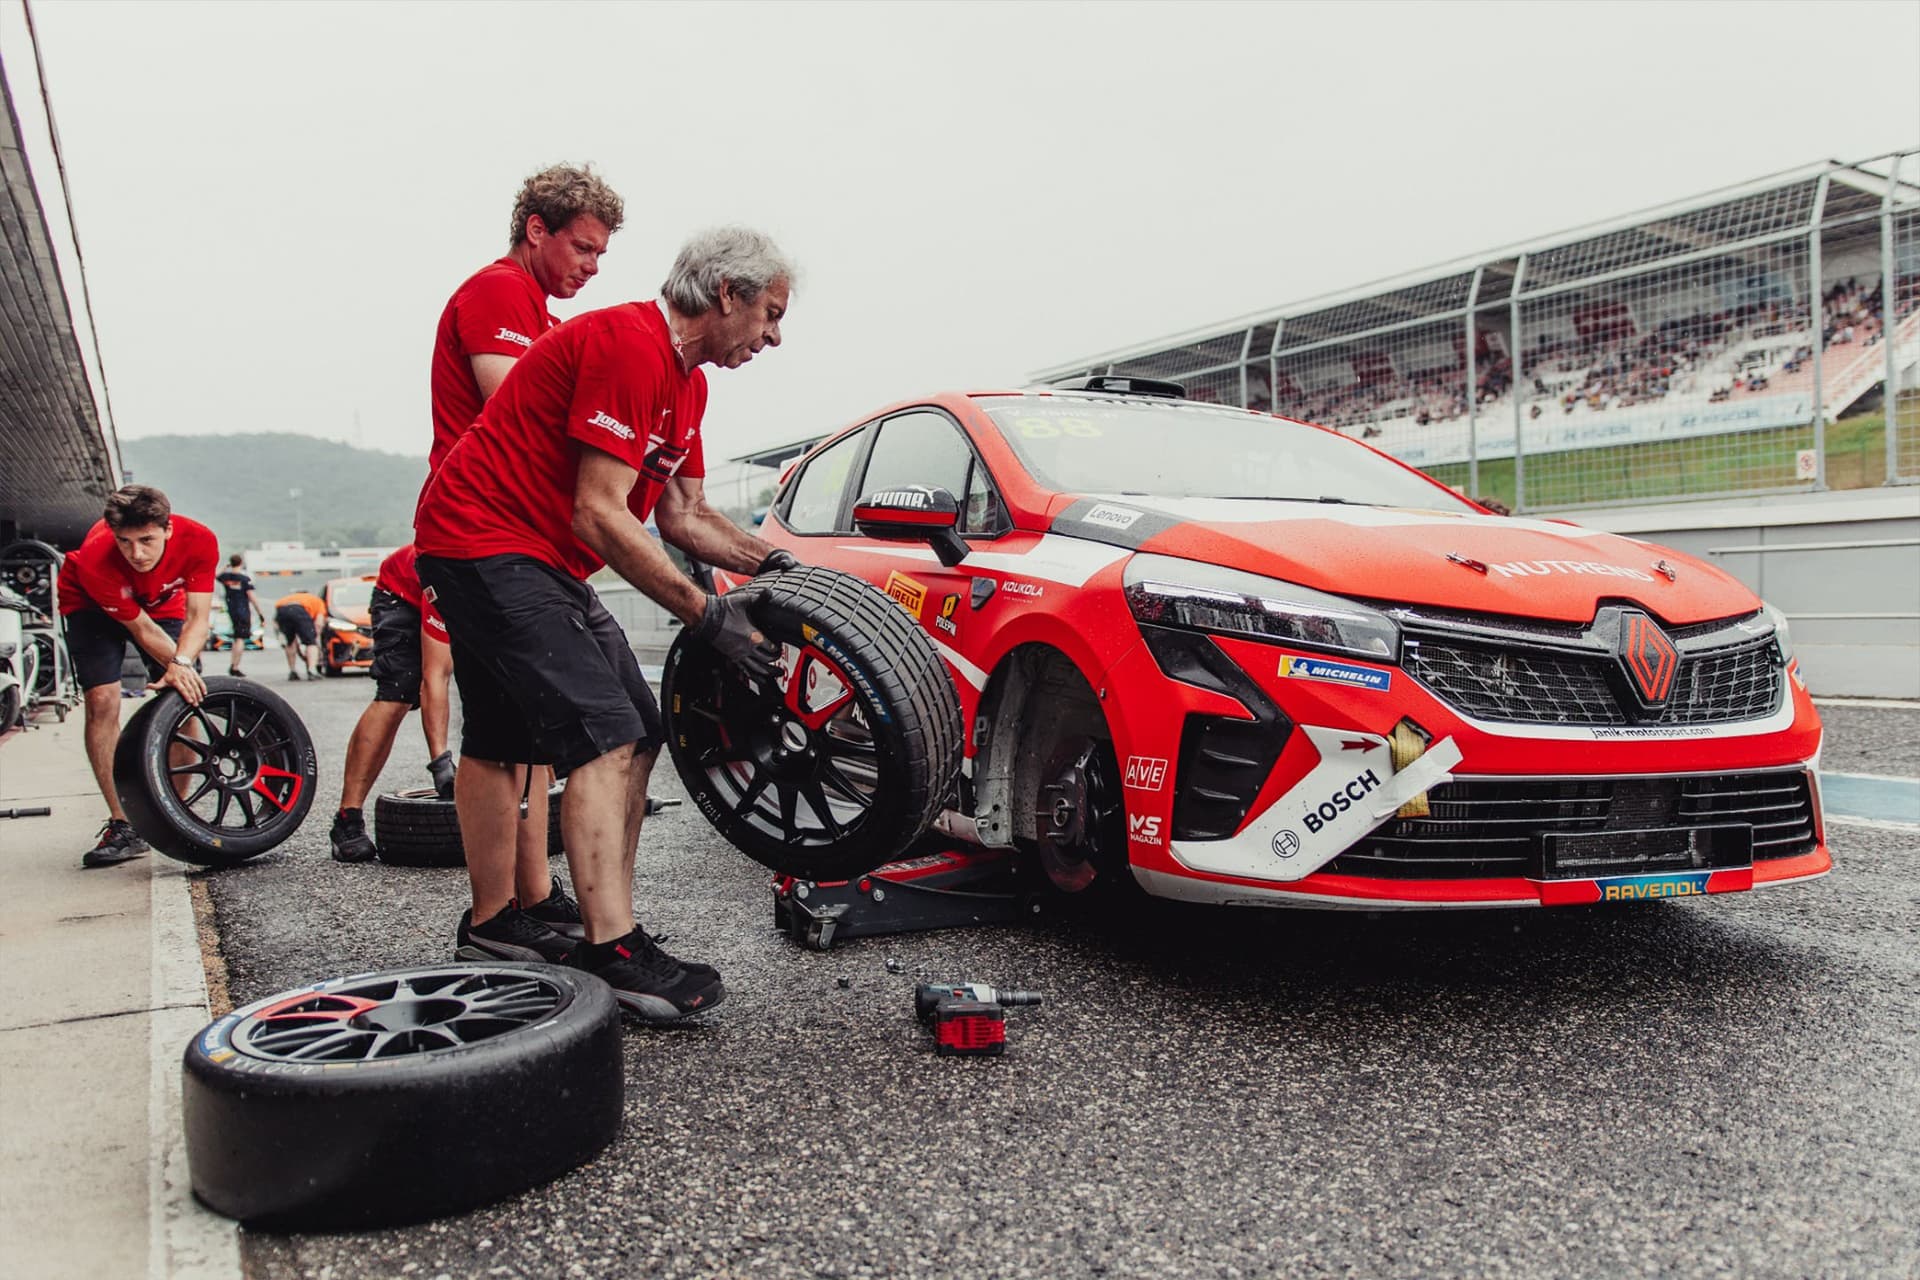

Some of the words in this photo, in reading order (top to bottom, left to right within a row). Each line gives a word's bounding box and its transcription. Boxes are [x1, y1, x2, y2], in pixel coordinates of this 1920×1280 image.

[1090, 508, 1132, 524] Lenovo
[1489, 560, 1655, 583] NUTREND
[1001, 580, 1044, 597] KOUKOLA
[826, 645, 886, 716] MICHELIN
[1311, 667, 1382, 684] MICHELIN
[1590, 727, 1714, 739] janik-motorsport.com
[1302, 769, 1381, 834] BOSCH
[1129, 813, 1162, 835] MS
[1130, 834, 1162, 846] MAGAZIN
[1605, 881, 1703, 901] RAVENOL
